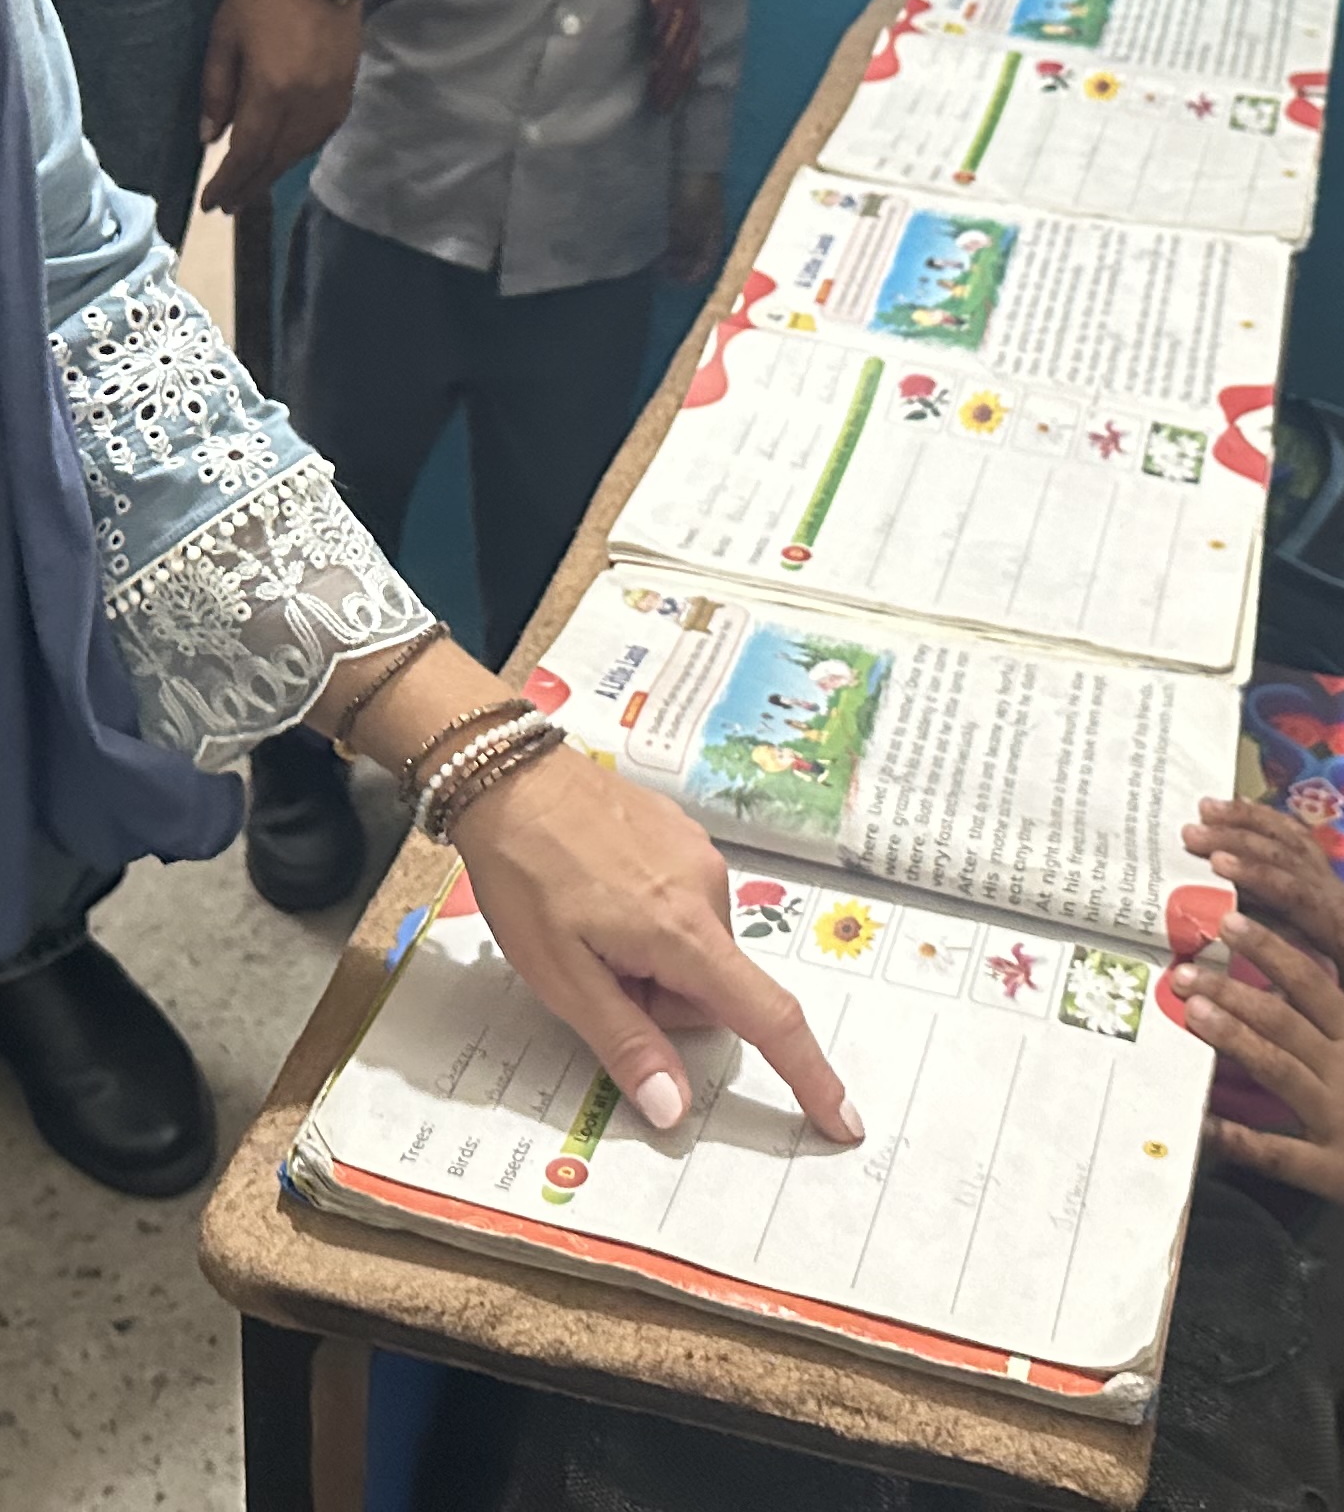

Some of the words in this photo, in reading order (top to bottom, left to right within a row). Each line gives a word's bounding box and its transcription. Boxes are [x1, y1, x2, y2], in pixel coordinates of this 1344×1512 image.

[980, 870, 999, 899] His
[399, 1118, 437, 1167] Trees:
[573, 1107, 601, 1144] Look
[446, 1133, 483, 1179] Birds:
[493, 1134, 536, 1193] Insects:
